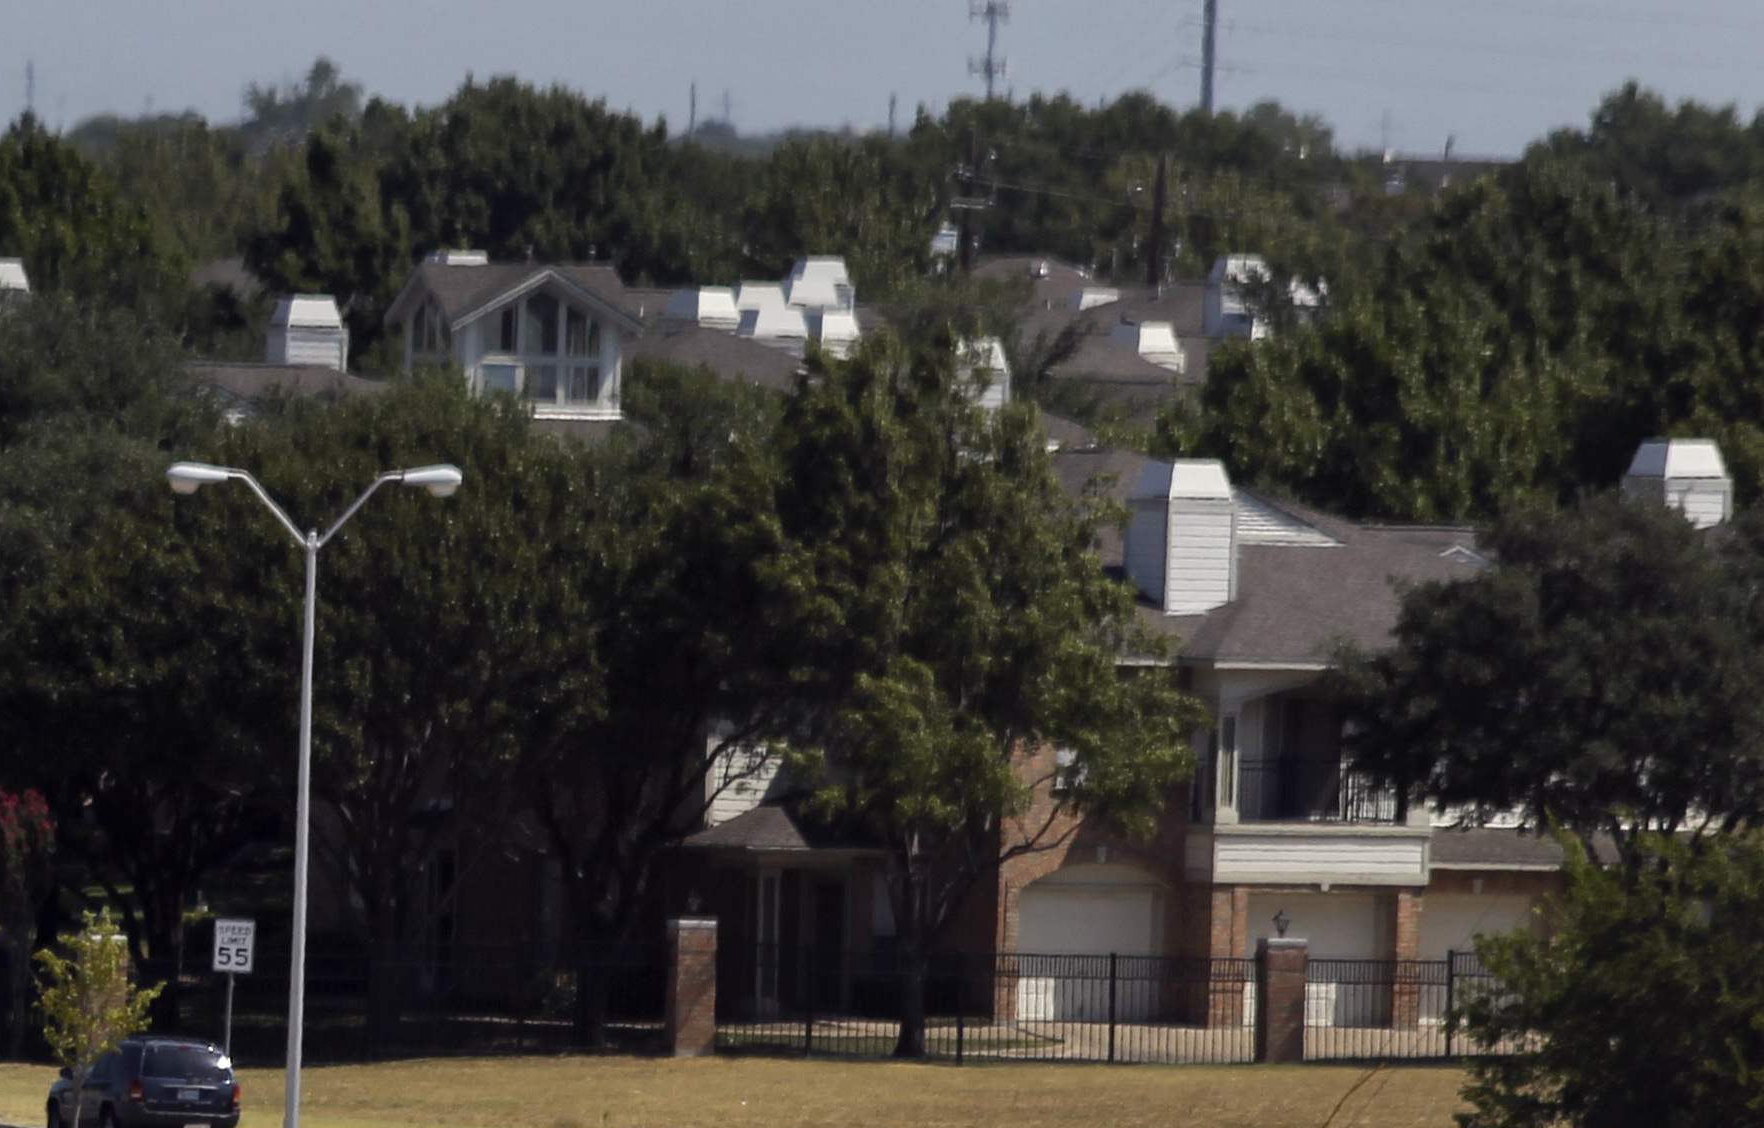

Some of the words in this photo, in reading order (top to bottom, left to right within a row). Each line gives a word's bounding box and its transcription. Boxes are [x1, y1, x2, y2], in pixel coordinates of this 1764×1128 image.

[219, 926, 251, 936] SPEED
[221, 936, 246, 945] LIMIT
[218, 946, 248, 966] 55
